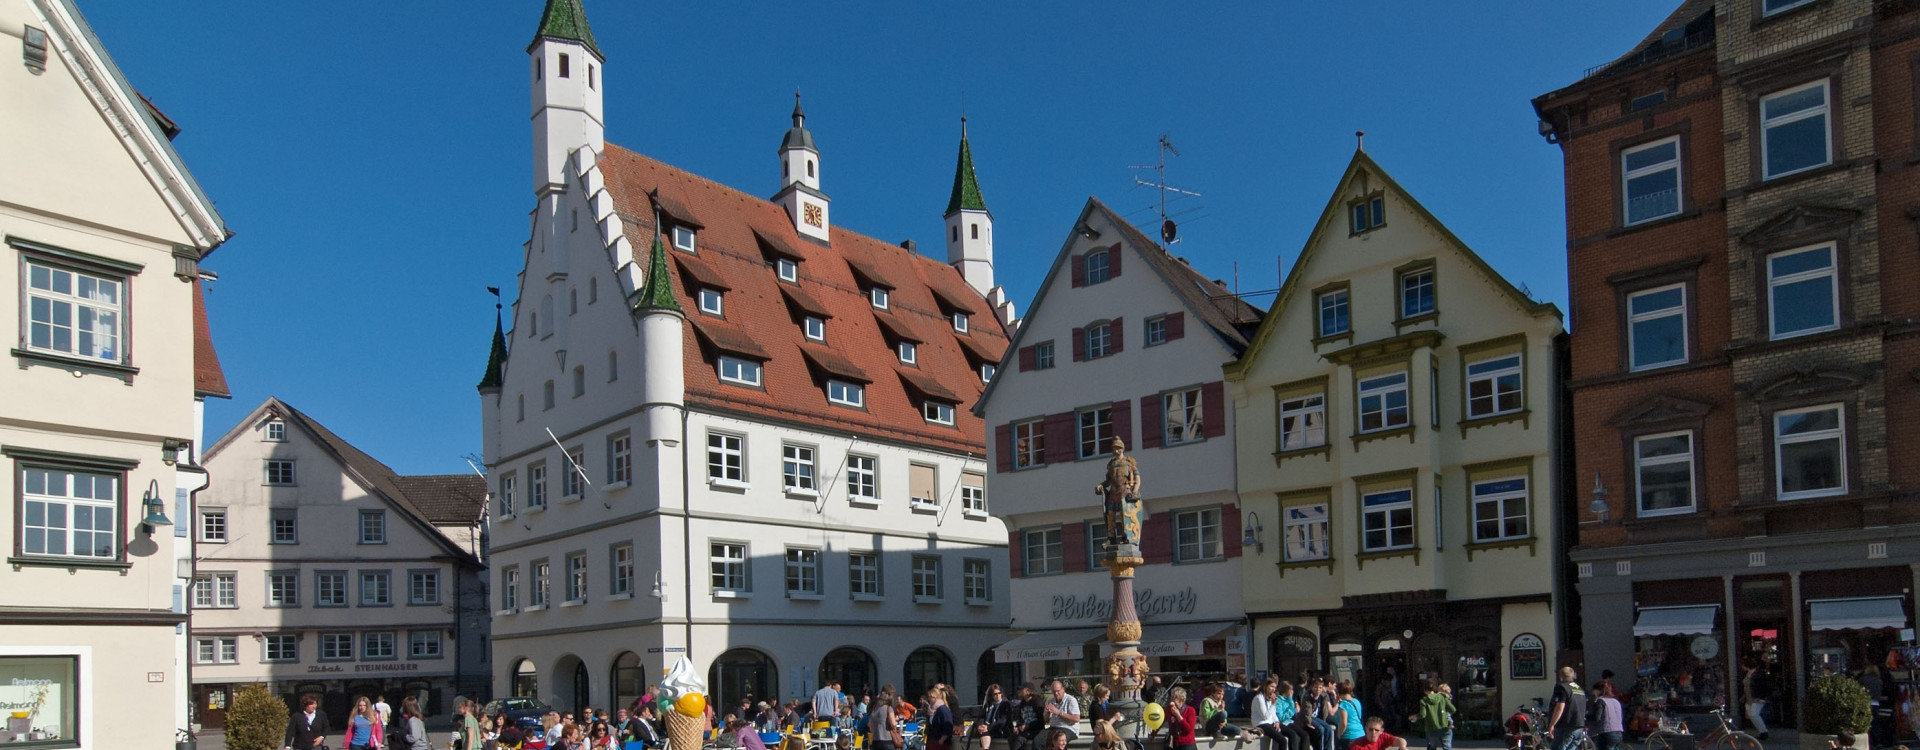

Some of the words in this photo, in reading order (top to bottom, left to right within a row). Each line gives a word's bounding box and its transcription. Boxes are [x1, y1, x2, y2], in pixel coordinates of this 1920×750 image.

[1040, 648, 1060, 658] Gelato
[1152, 642, 1175, 655] Gelato
[354, 663, 418, 673] STEINHAUSER
